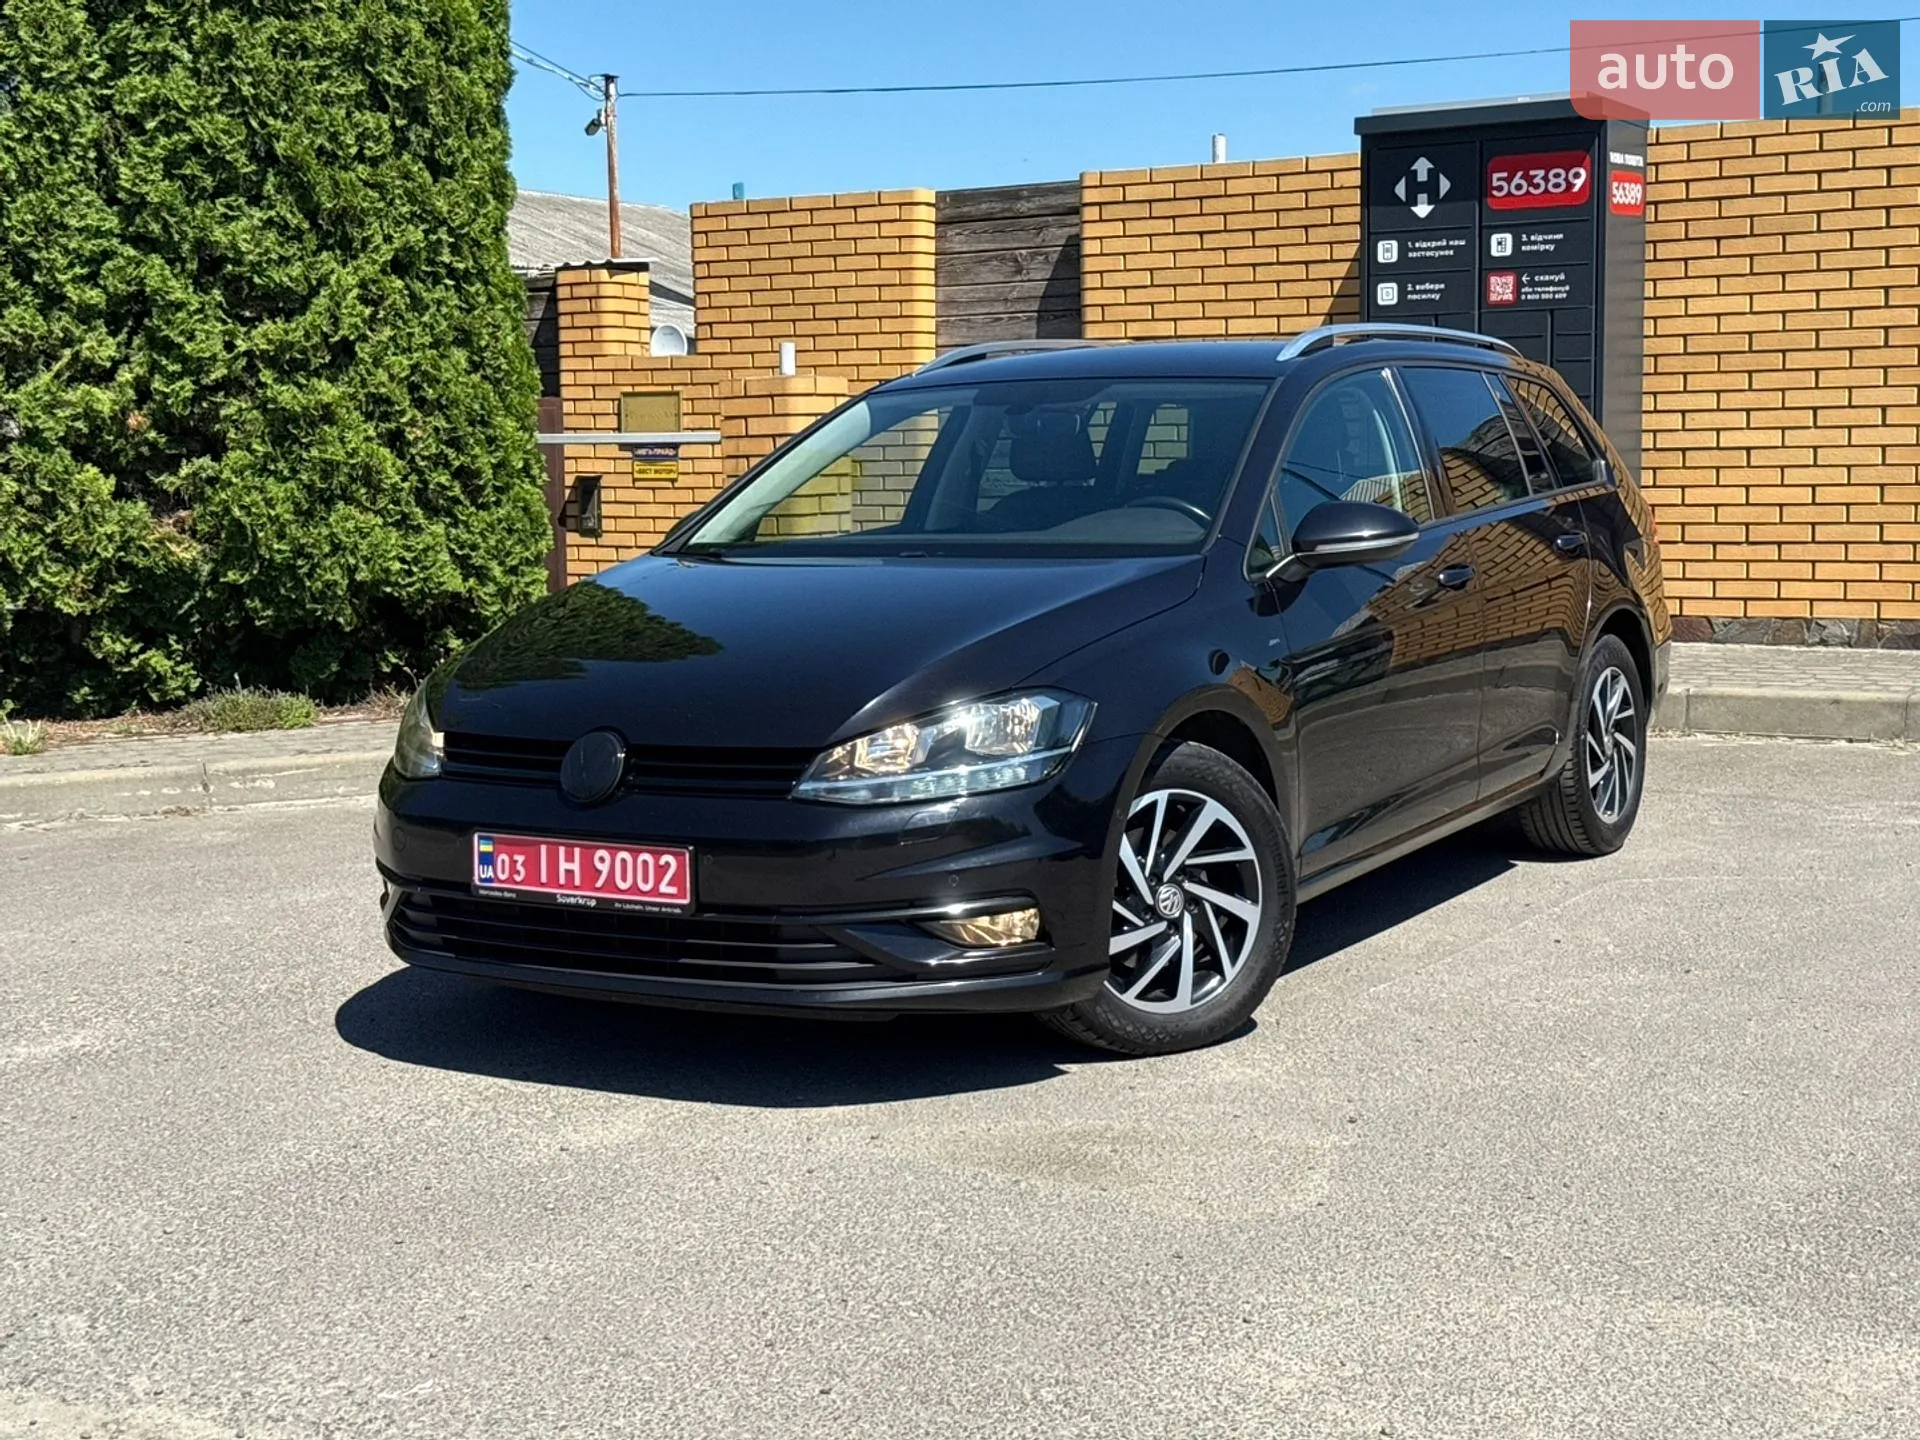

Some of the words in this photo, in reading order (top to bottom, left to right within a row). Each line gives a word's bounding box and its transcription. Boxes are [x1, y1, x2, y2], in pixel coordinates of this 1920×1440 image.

[1491, 166, 1587, 197] 56389
[1611, 181, 1643, 206] 56389
[1521, 242, 1555, 252] комірку
[1534, 271, 1566, 282] скануй
[480, 864, 494, 879] UA
[497, 853, 526, 882] 03
[540, 844, 580, 887] IH
[593, 849, 678, 895] 9002
